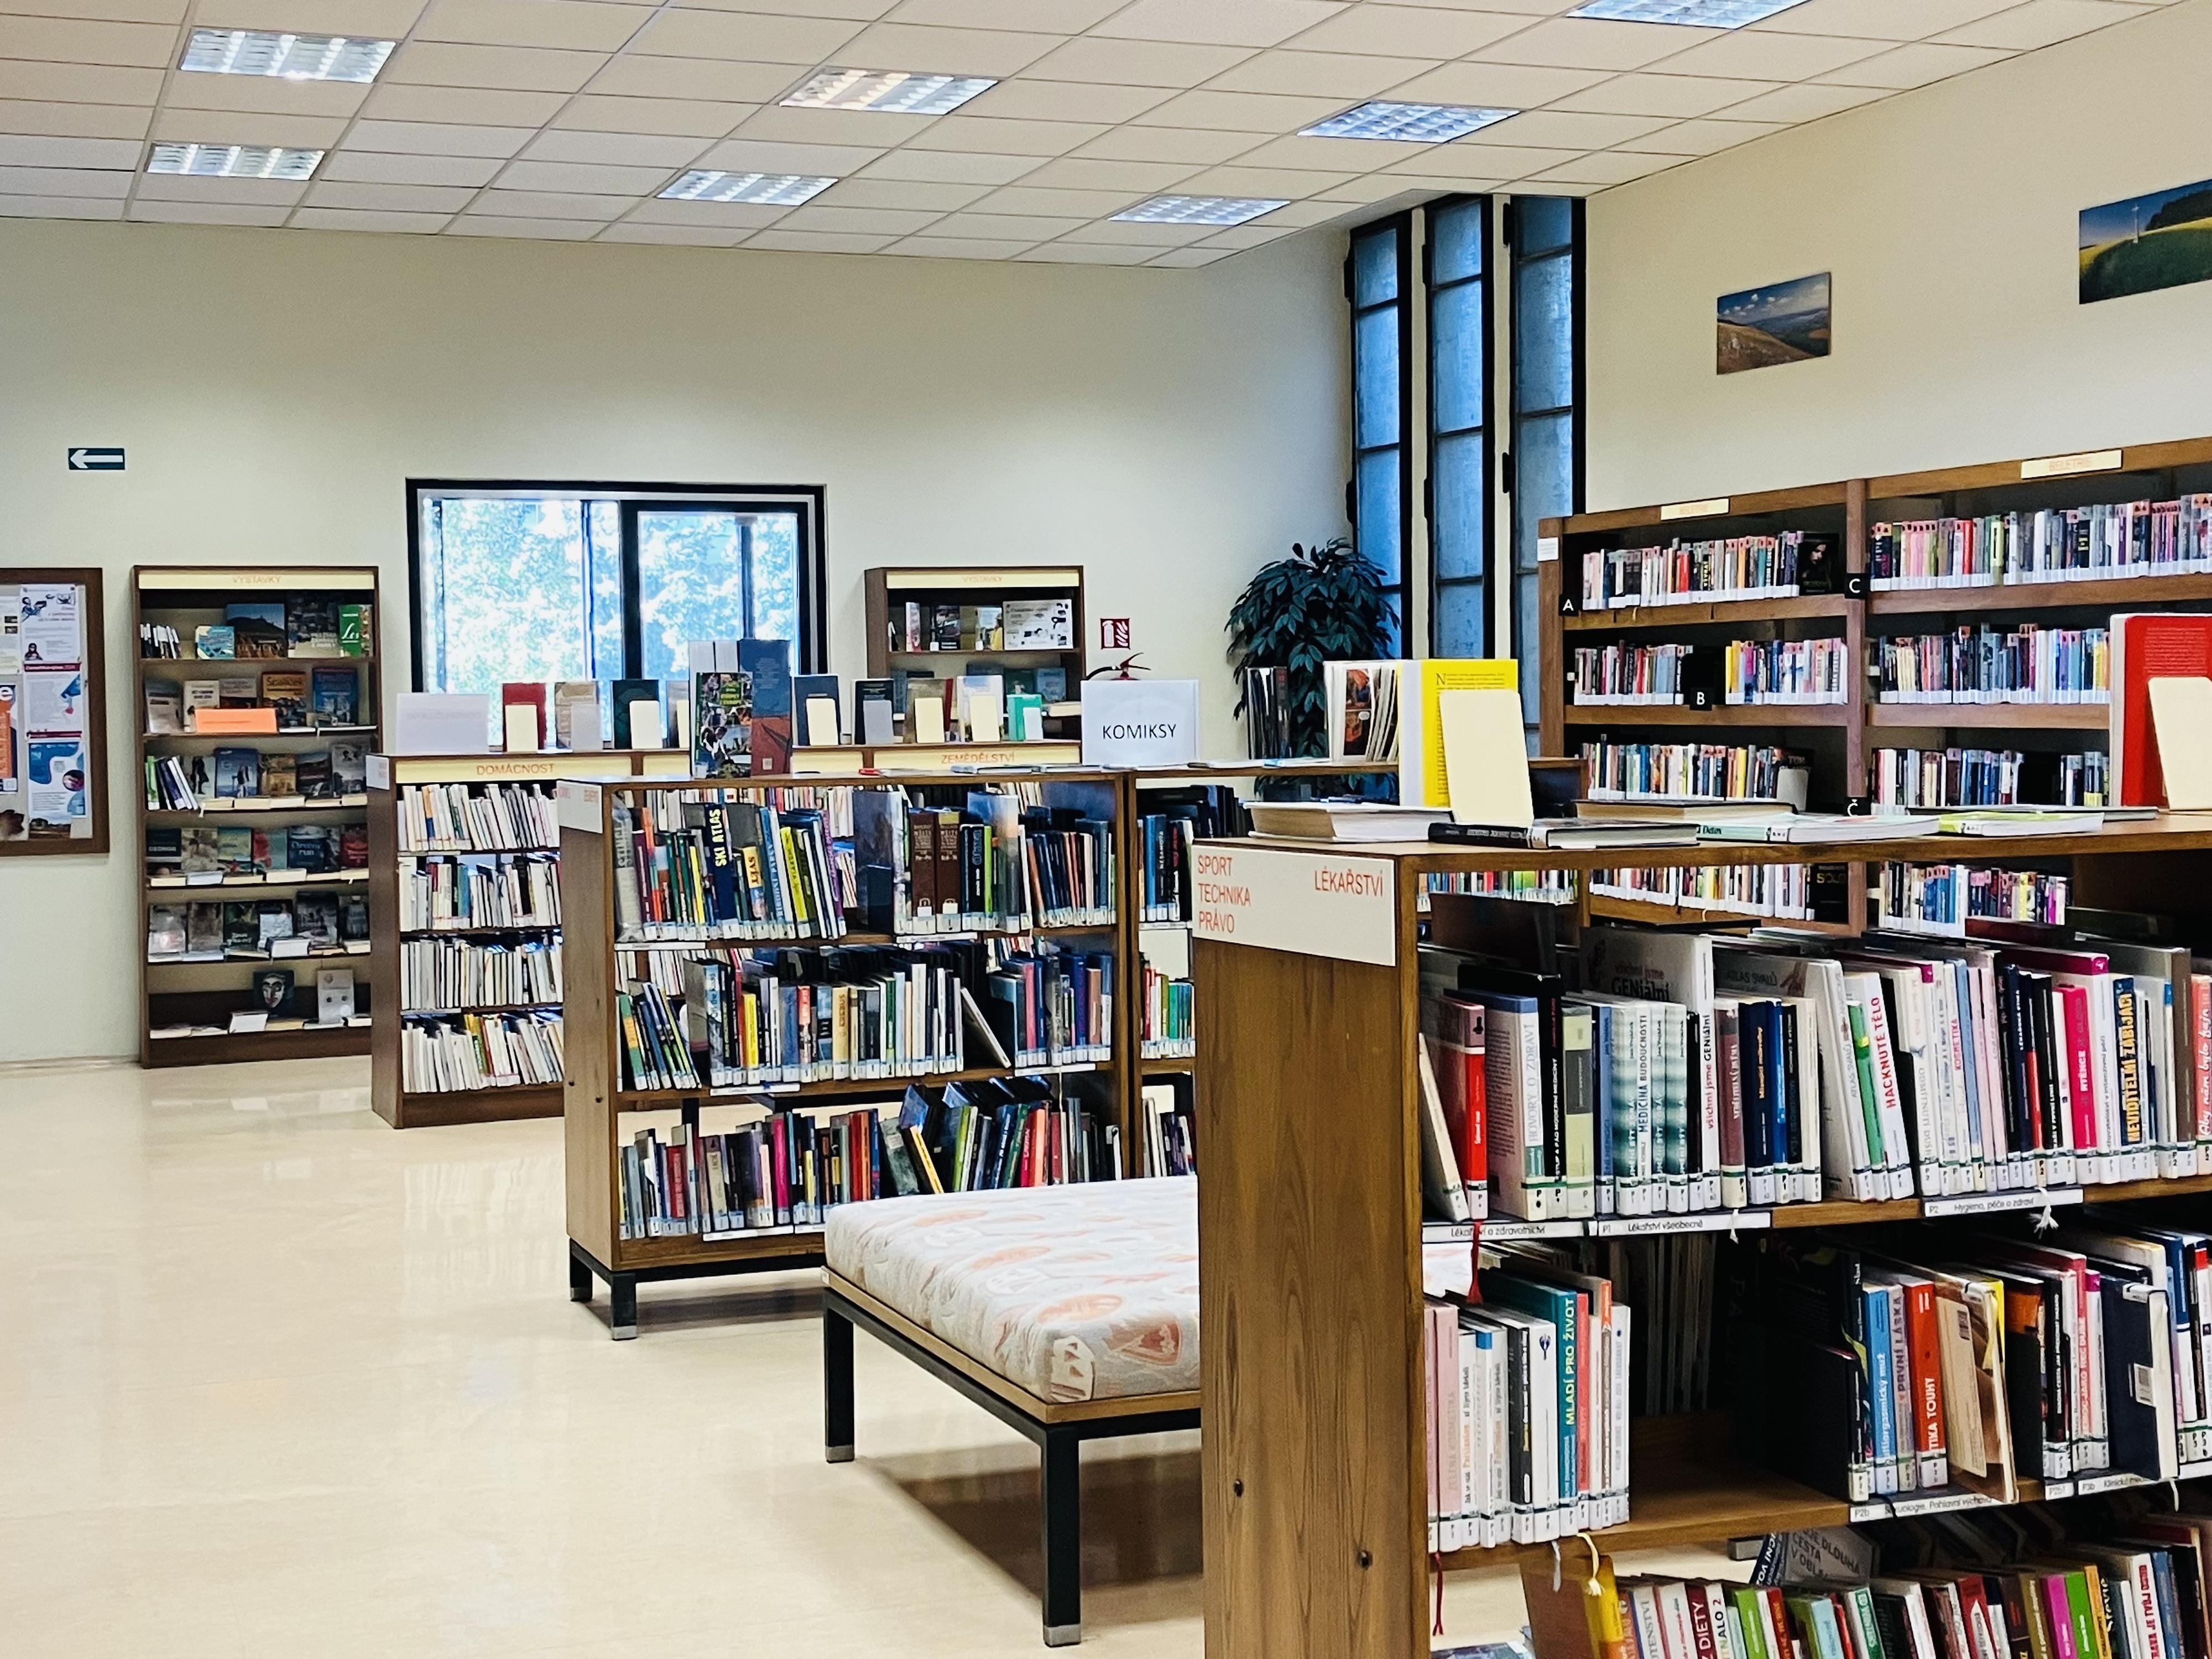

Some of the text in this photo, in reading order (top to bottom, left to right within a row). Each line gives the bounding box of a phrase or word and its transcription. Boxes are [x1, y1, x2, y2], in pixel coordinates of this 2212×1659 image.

[1849, 572, 1861, 593] C
[1563, 600, 1574, 612] A
[1696, 692, 1705, 705] B
[1102, 723, 1176, 741] KOMIKSY
[476, 762, 555, 776] DOMÁCNOST
[940, 750, 1015, 765] ZEMĚDĚLSTVÍ
[709, 808, 727, 867] SKI ATLAS
[1197, 855, 1233, 878] SPORT
[1314, 866, 1384, 898] LÉKAŘSTVÍ
[1198, 883, 1251, 907] TECHNIKA
[1198, 908, 1235, 934] PRÁVO
[1524, 1024, 1535, 1071] ZDRAVÍ
[1870, 997, 1896, 1108] HACKNUTÉ TĚLO
[1951, 1018, 1961, 1071] KOSMETIKA
[1638, 1015, 1648, 1133] MEDICÍNA BUDOUCNOSTI
[1702, 1015, 1714, 1129] všichni jsme GENiální
[2118, 993, 2140, 1141] NEVIDITELNÍ ZABIJÁCI
[2200, 1083, 2210, 1105] nám
[1527, 1093, 1538, 1141] HOVORY
[2198, 1110, 2211, 1136] Aby
[1563, 1297, 1574, 1425] MLADÍ PRO ŽIVOT
[1892, 1296, 1906, 1391] PRVNÍ LÁSKA
[1879, 1380, 1891, 1455] ltiorgasmický
[1925, 1377, 1939, 1449] TIKA TOUHY
[1791, 1545, 1797, 1559] V
[1793, 1533, 1822, 1563] CESTA
[1641, 1600, 1660, 1659] TENSTVÍ
[1692, 1601, 1711, 1650] DIETY
